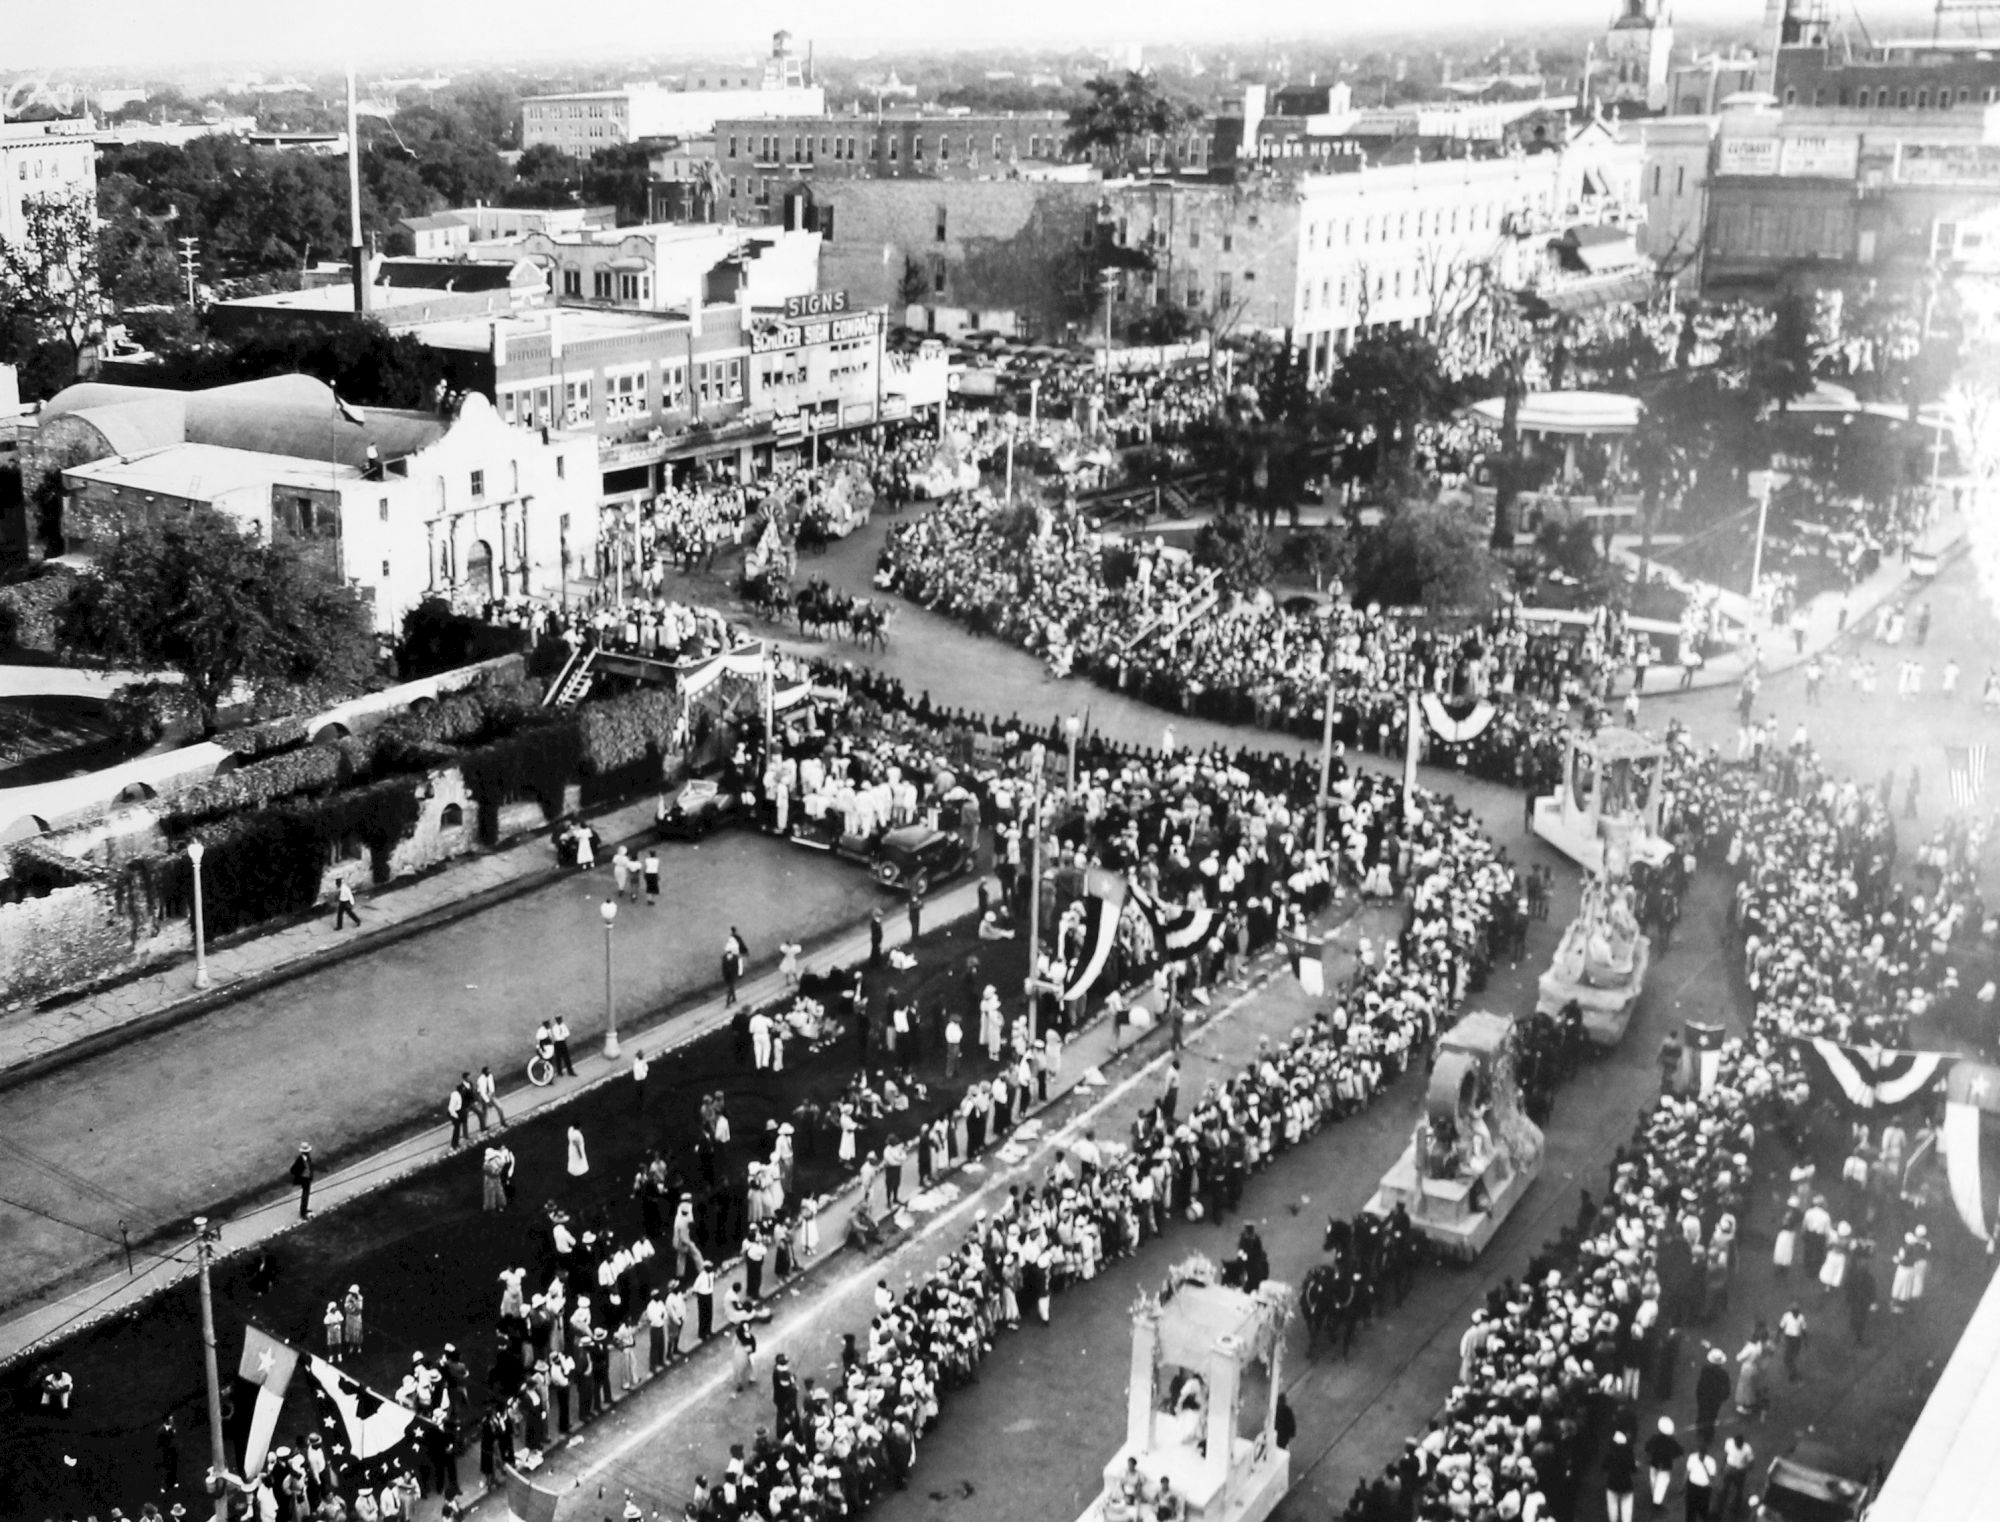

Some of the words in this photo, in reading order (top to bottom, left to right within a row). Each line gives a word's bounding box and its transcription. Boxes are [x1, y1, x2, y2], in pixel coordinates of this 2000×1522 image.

[1309, 141, 1360, 156] HOTEL
[788, 291, 845, 317] SIGNS
[804, 323, 830, 345] SIGN
[832, 314, 880, 341] COMPANY
